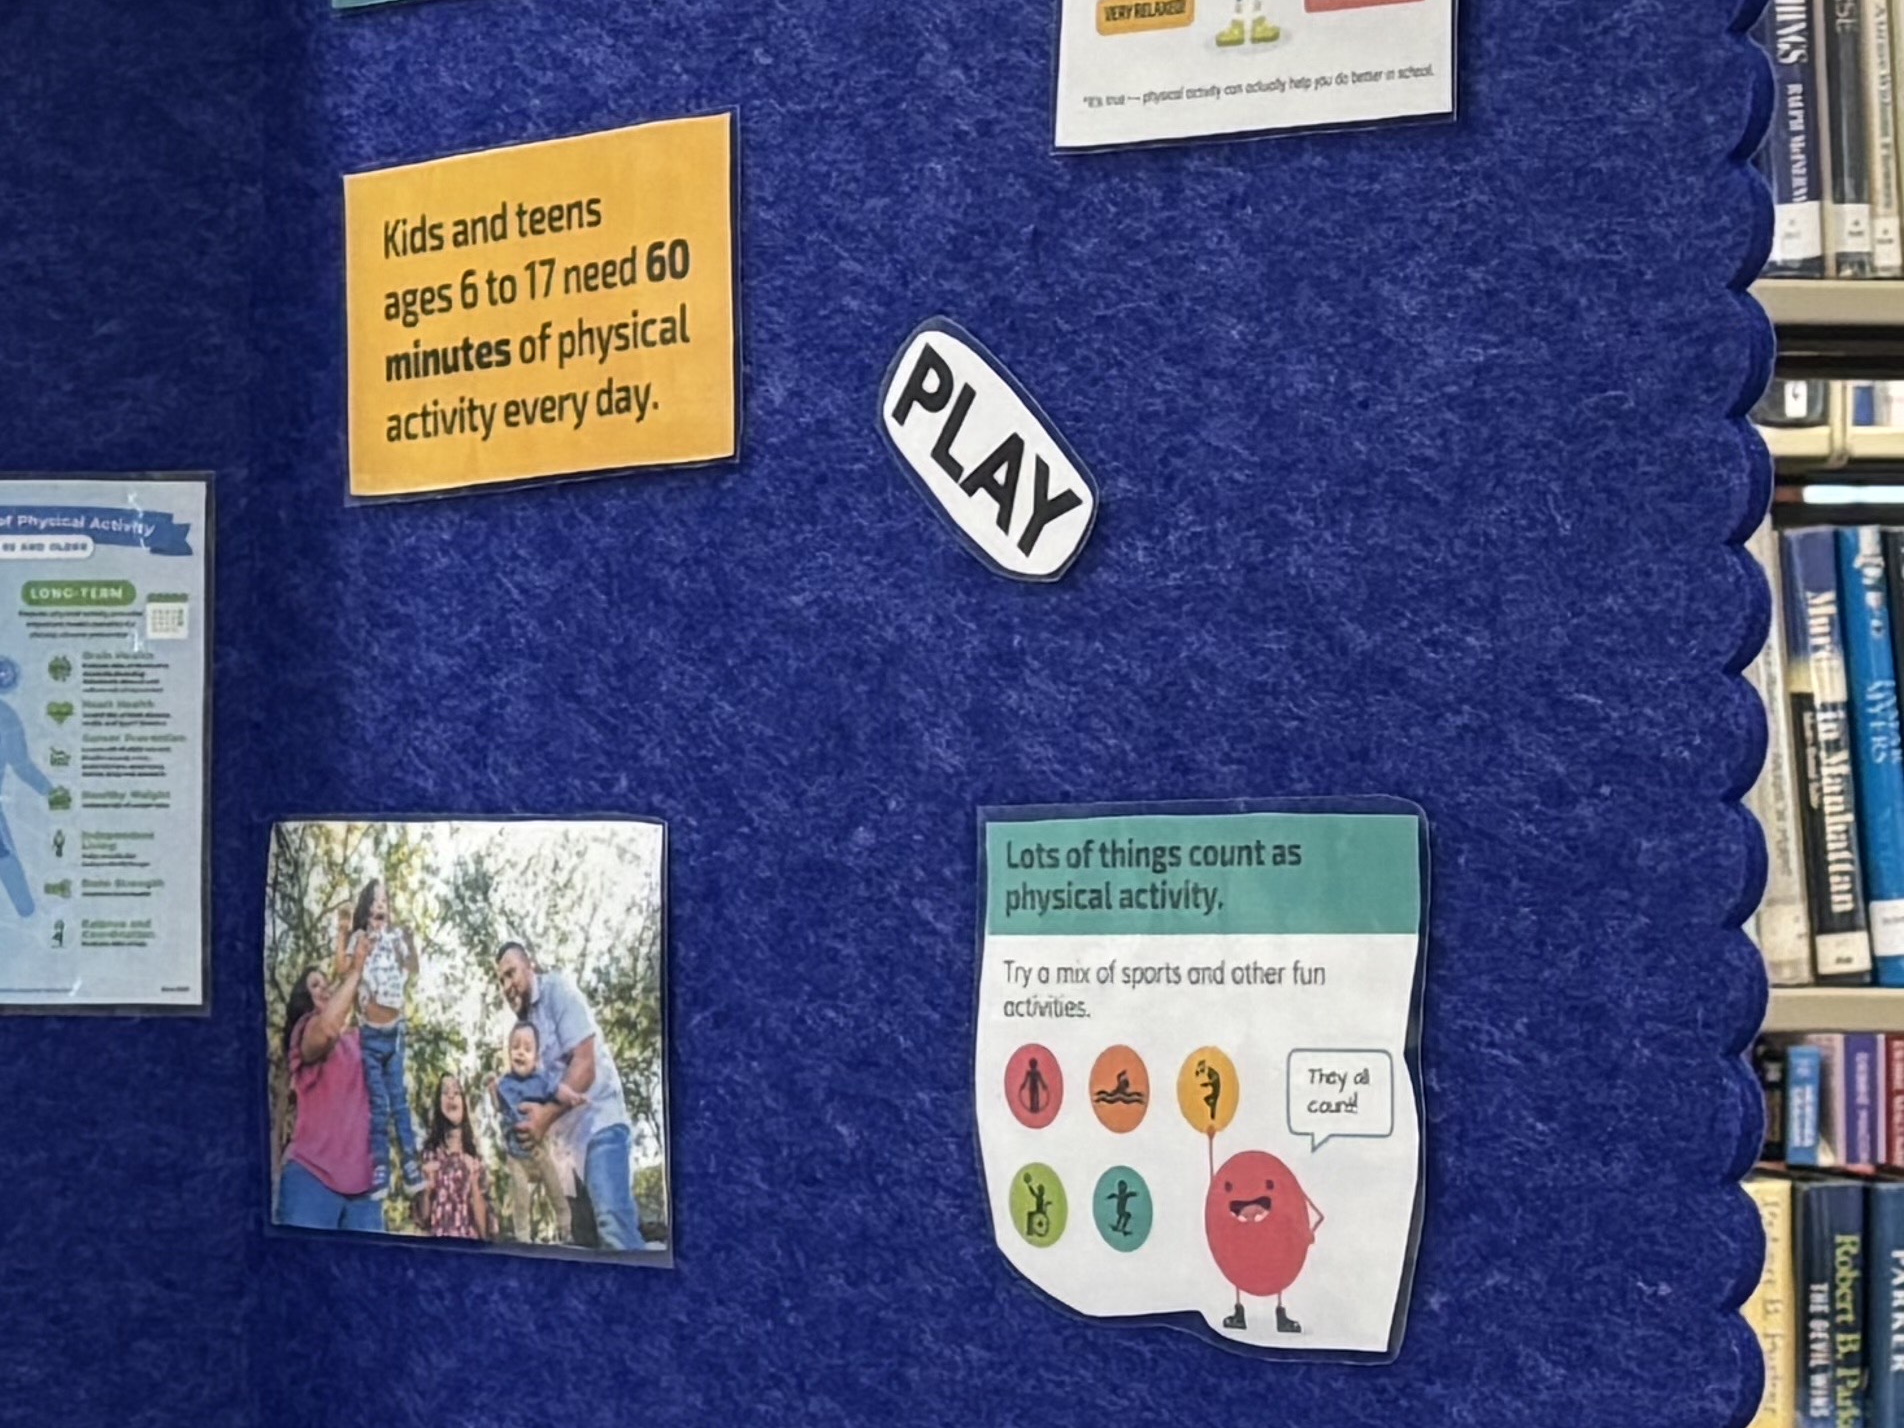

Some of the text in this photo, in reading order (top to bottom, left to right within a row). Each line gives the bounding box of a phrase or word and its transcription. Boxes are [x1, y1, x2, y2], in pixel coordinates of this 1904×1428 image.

[384, 197, 602, 259] Kids and teens
[384, 238, 690, 328] ages 6 to 17 need 60
[385, 303, 691, 382] minutes of physical
[386, 377, 659, 443] activity every day.
[890, 341, 1084, 559] PLAY
[1007, 838, 1302, 872] Lots of things count as
[1819, 748, 1859, 914] Manhattan
[1006, 879, 1224, 918] physical activity.
[1834, 1233, 1862, 1327] Robert
[1836, 1331, 1861, 1359] B.
